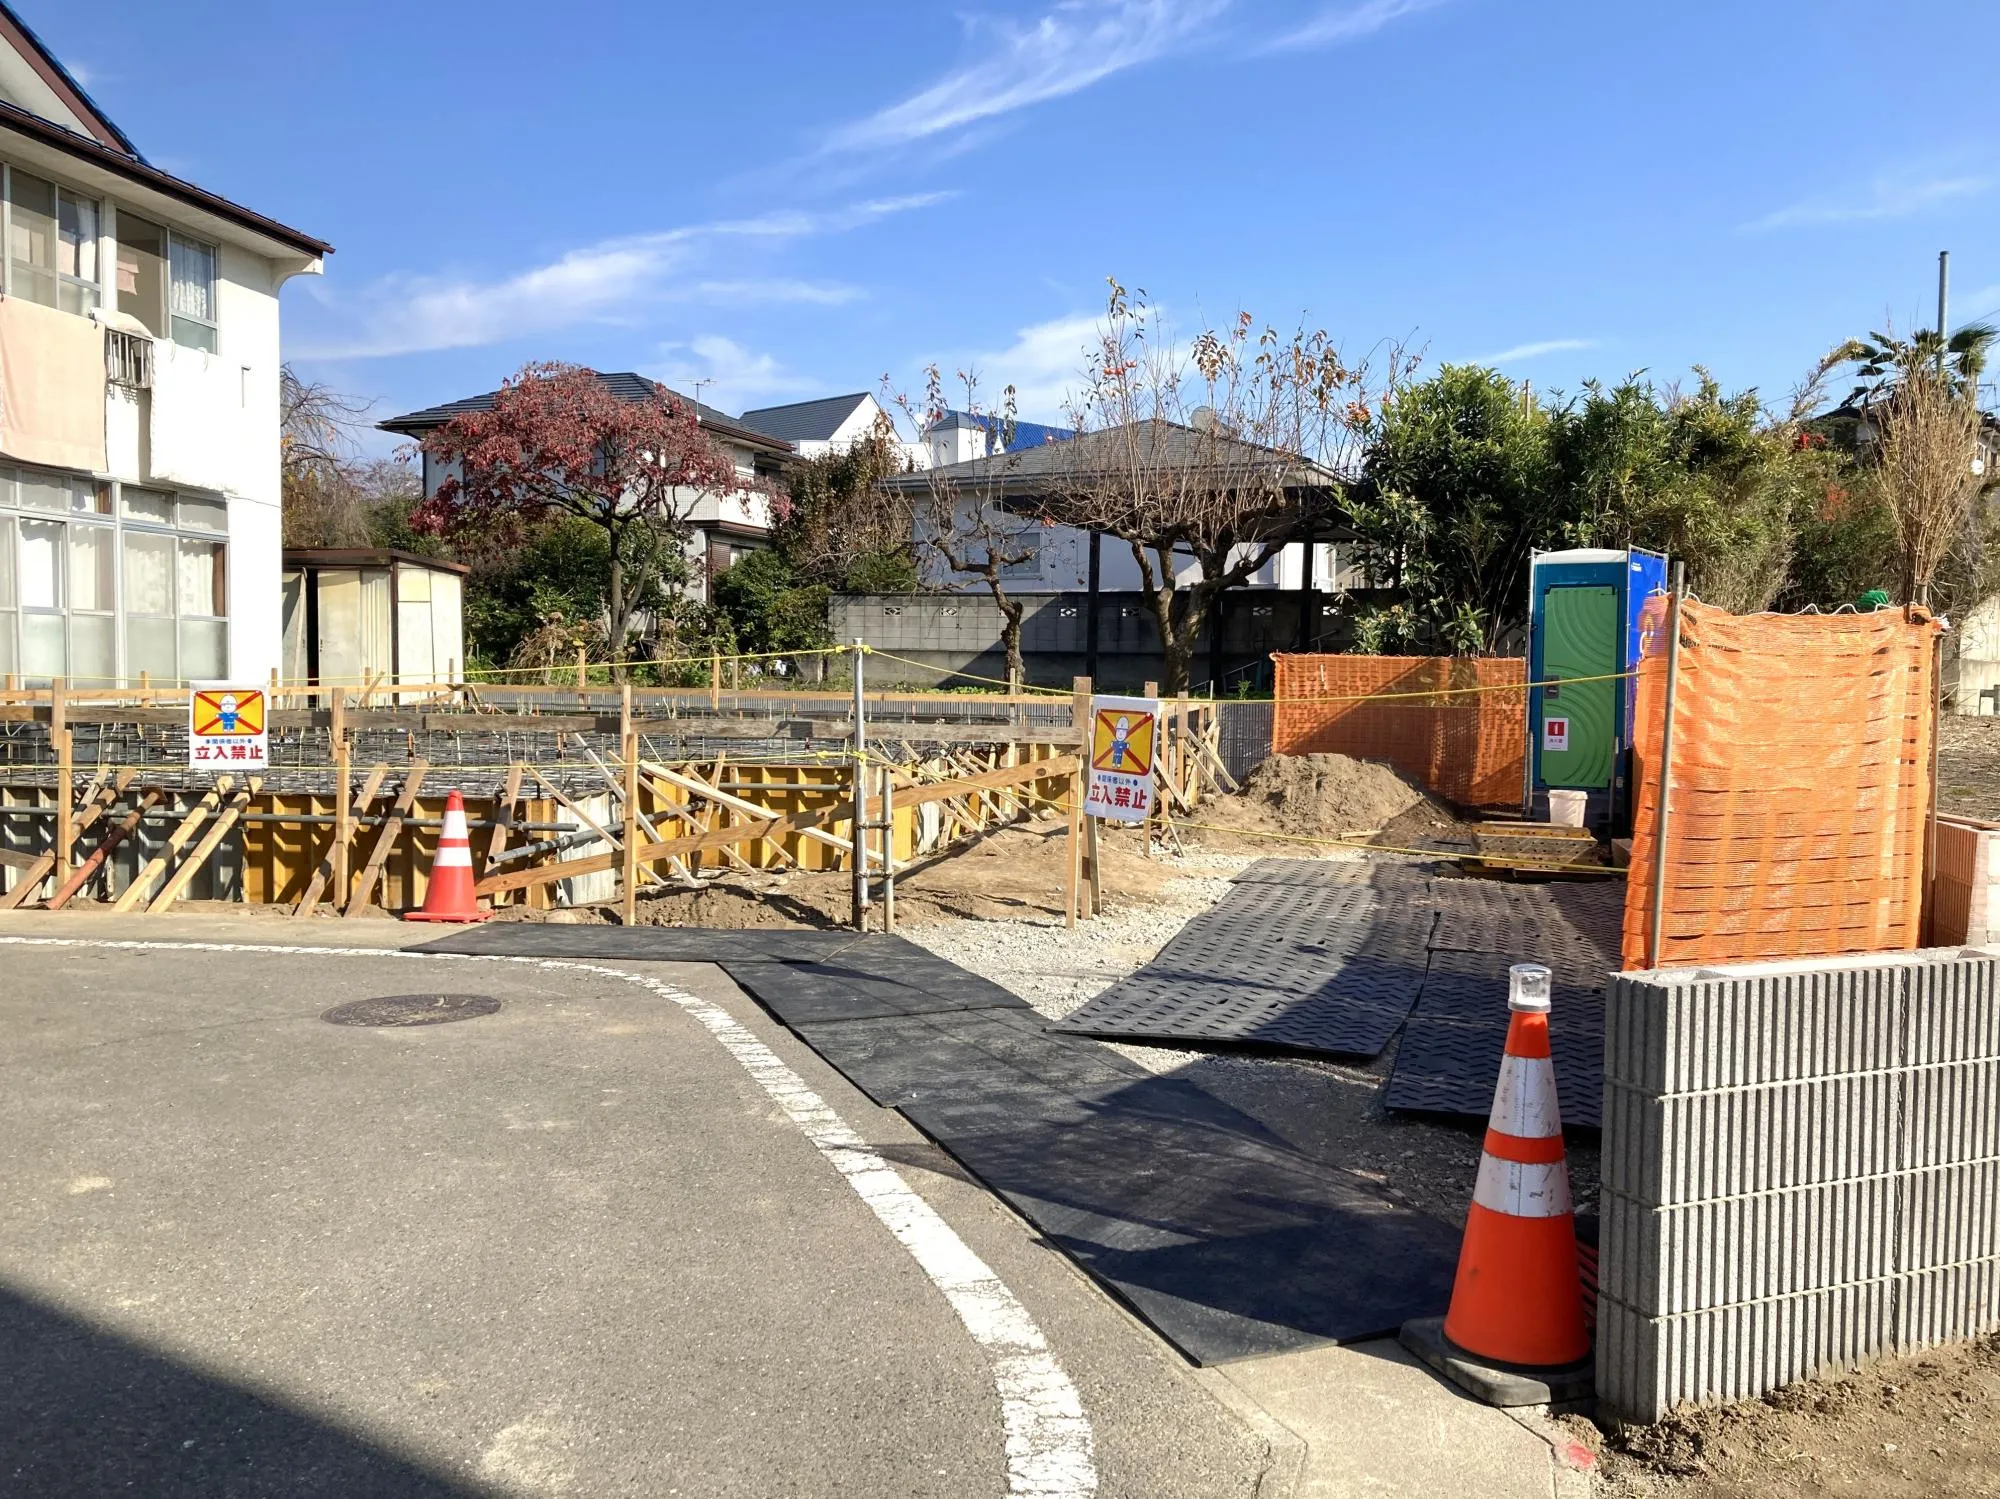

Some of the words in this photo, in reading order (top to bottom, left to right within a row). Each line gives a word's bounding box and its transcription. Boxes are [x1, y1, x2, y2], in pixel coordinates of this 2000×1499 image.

[194, 745, 263, 760] 立入禁止
[1089, 783, 1148, 810] 立入禁止
